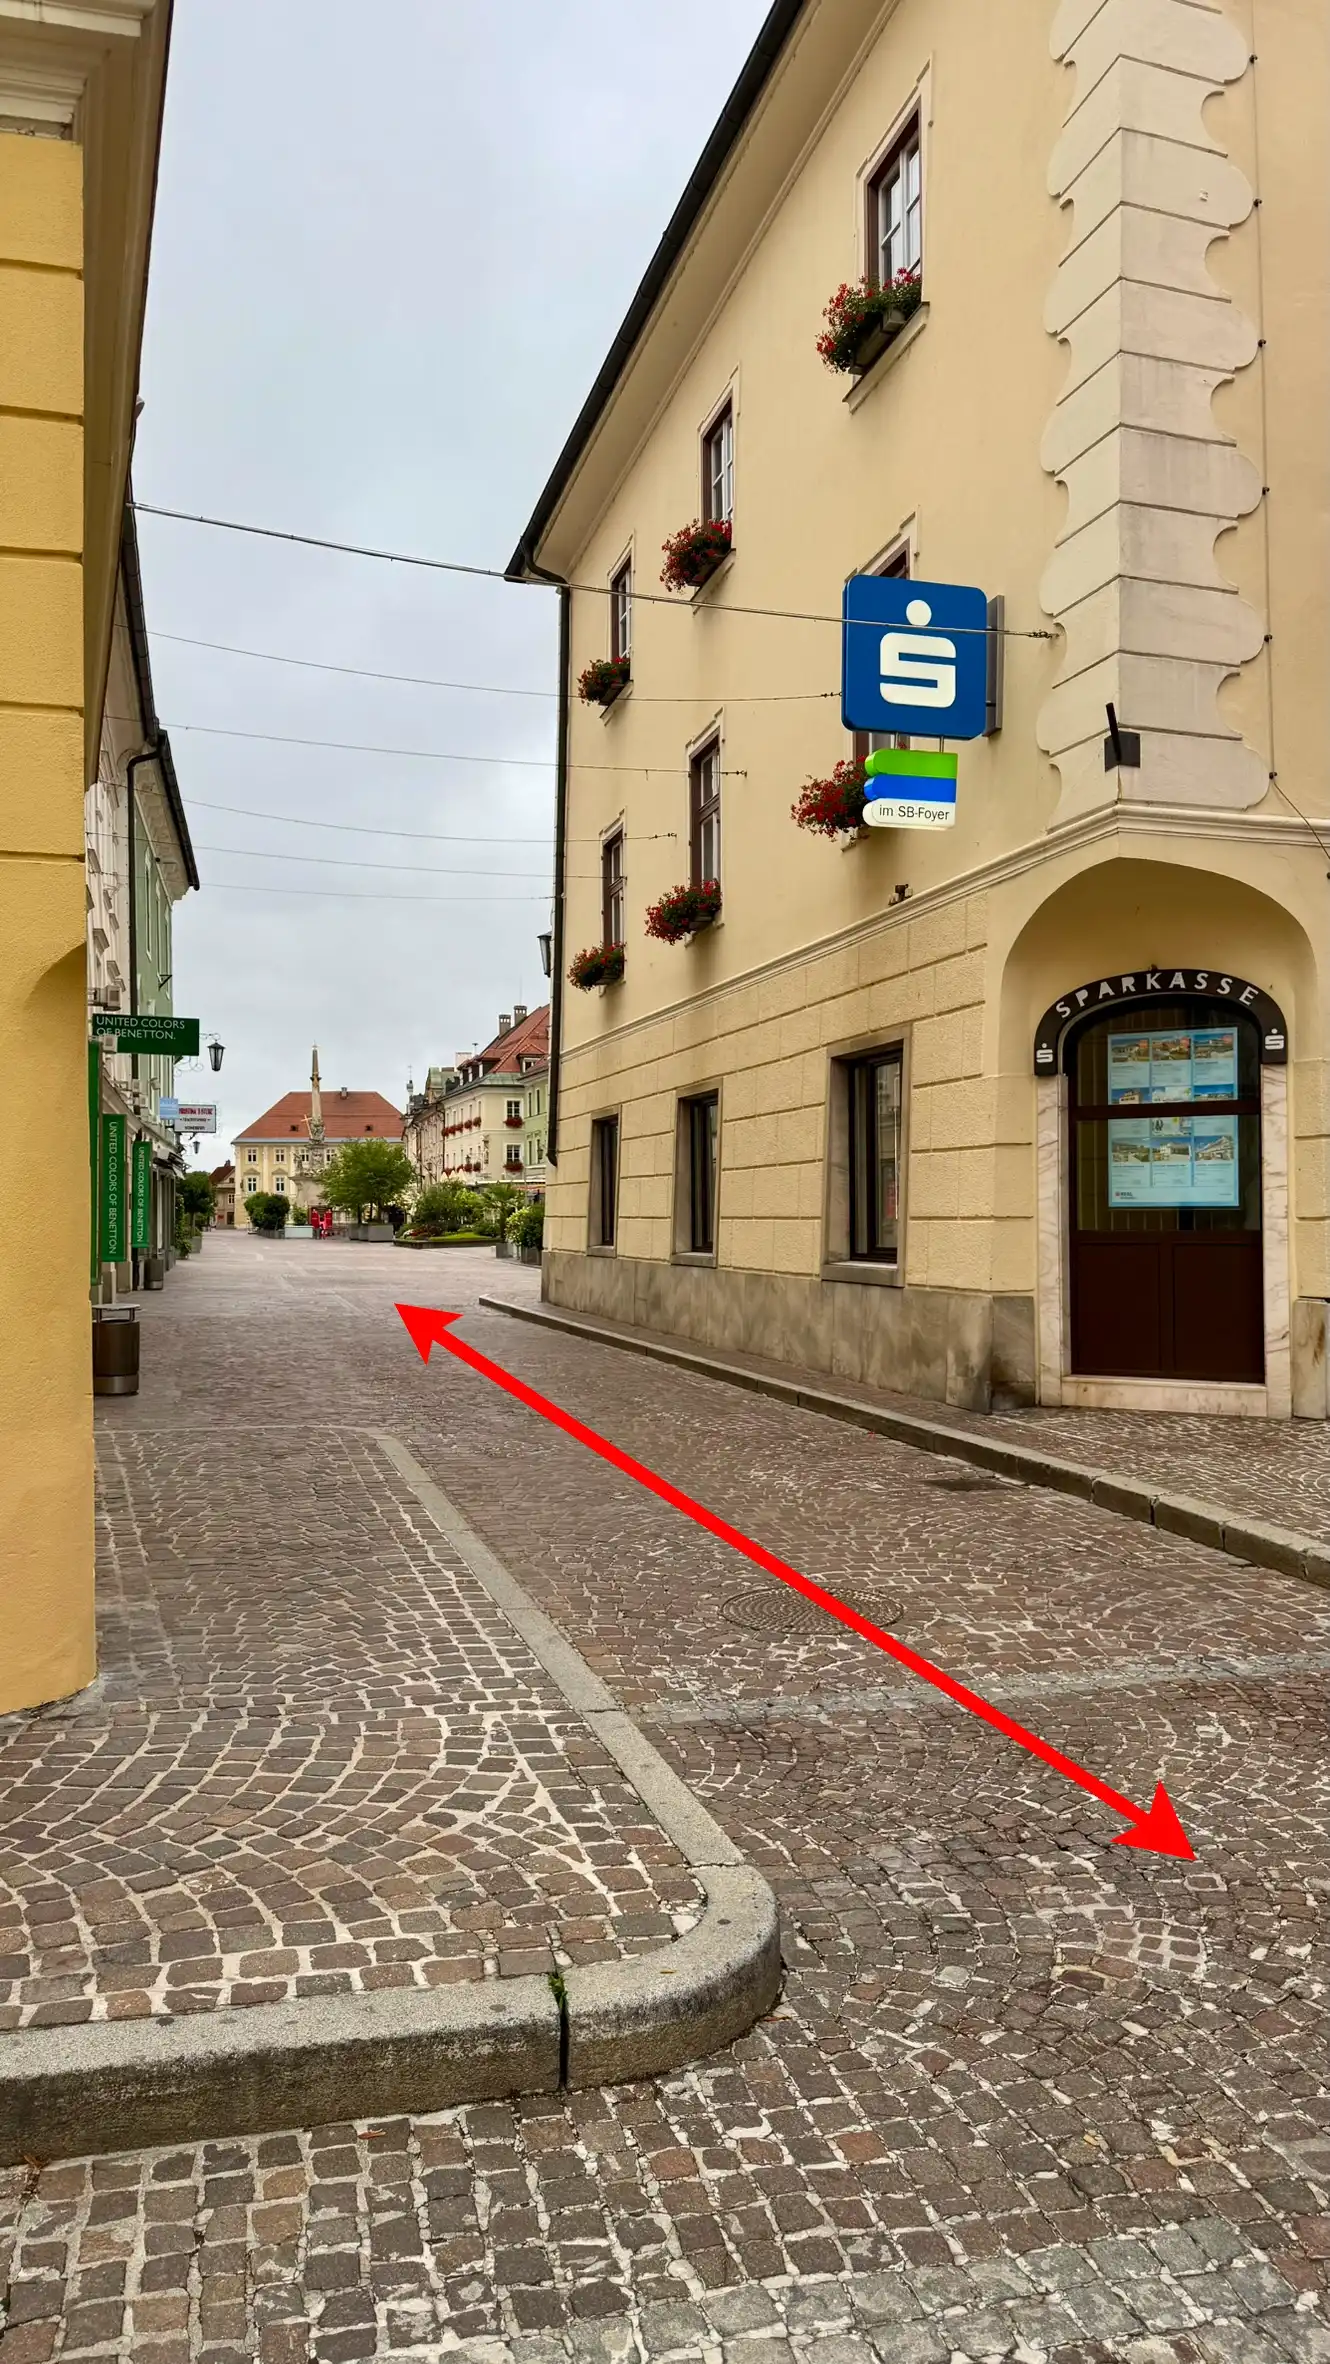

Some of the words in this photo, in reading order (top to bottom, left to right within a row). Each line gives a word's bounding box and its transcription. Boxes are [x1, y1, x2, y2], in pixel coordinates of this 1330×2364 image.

[879, 804, 894, 816] im
[898, 805, 950, 822] SB-Foyer
[1055, 972, 1259, 1019] SPARKASSE
[96, 1016, 139, 1027] UNITED
[140, 1018, 185, 1029] COLORS
[108, 1121, 118, 1154] UNITED
[108, 1156, 118, 1192] COLORS
[137, 1171, 145, 1197] COLORS
[108, 1194, 118, 1206] OF
[137, 1198, 145, 1207] OF
[108, 1208, 118, 1254] BENETTON
[136, 1208, 144, 1242] BENETTON
